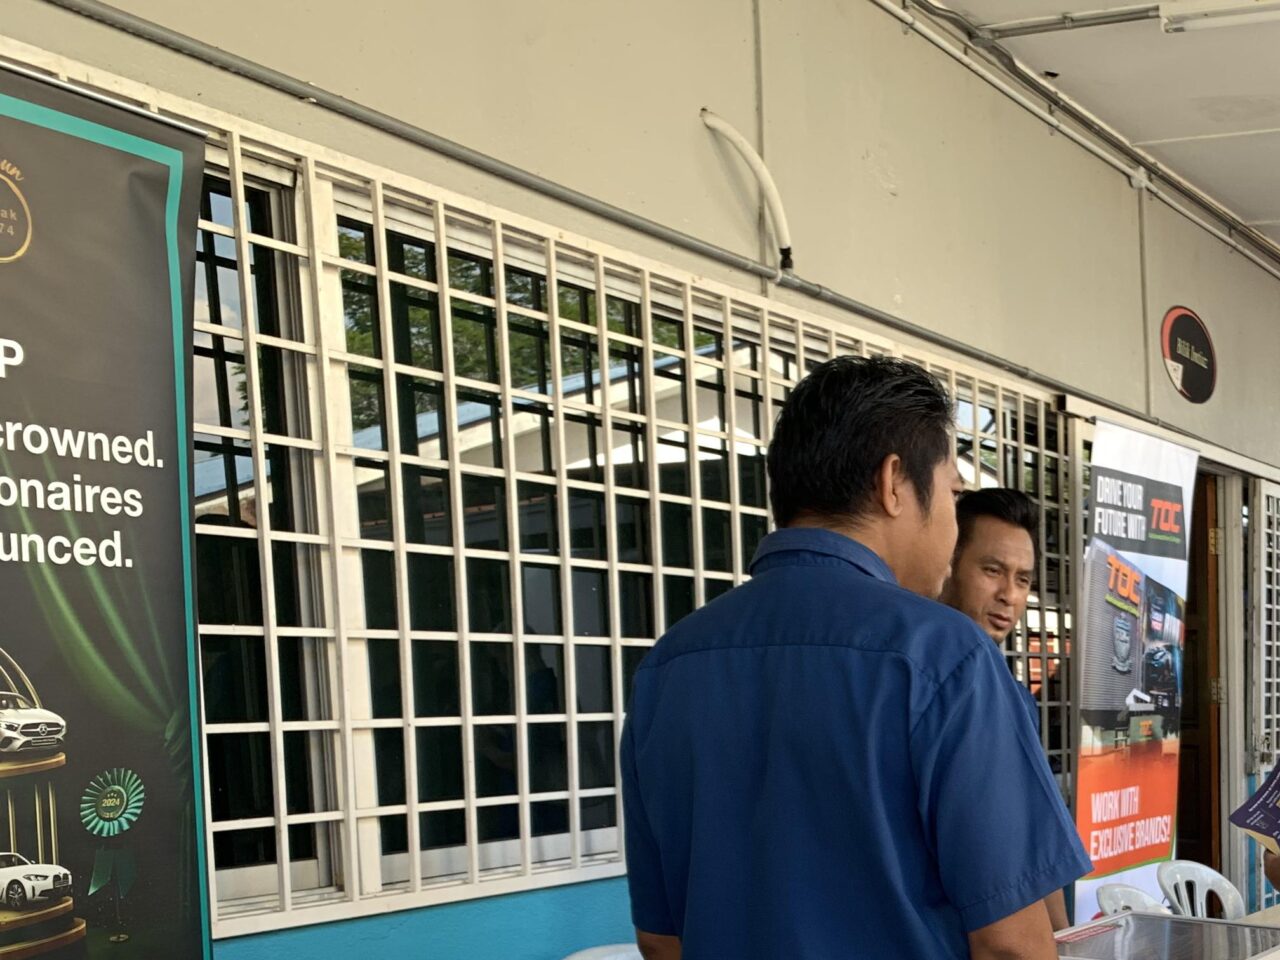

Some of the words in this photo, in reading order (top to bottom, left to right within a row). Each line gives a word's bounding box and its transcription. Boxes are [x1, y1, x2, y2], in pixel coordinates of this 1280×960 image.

[0, 420, 163, 468] rowned.
[1097, 475, 1122, 506] DRIVE
[1122, 482, 1143, 511] YOUR
[1094, 506, 1126, 538] FUTURE
[1127, 513, 1146, 541] WITH
[1106, 554, 1142, 606] TOC
[102, 798, 120, 807] 2024
[1091, 789, 1120, 824] WORK
[1120, 784, 1140, 818] WITH
[1090, 822, 1135, 861] EXCLUSIVE
[1135, 814, 1171, 849] BRANDS!
